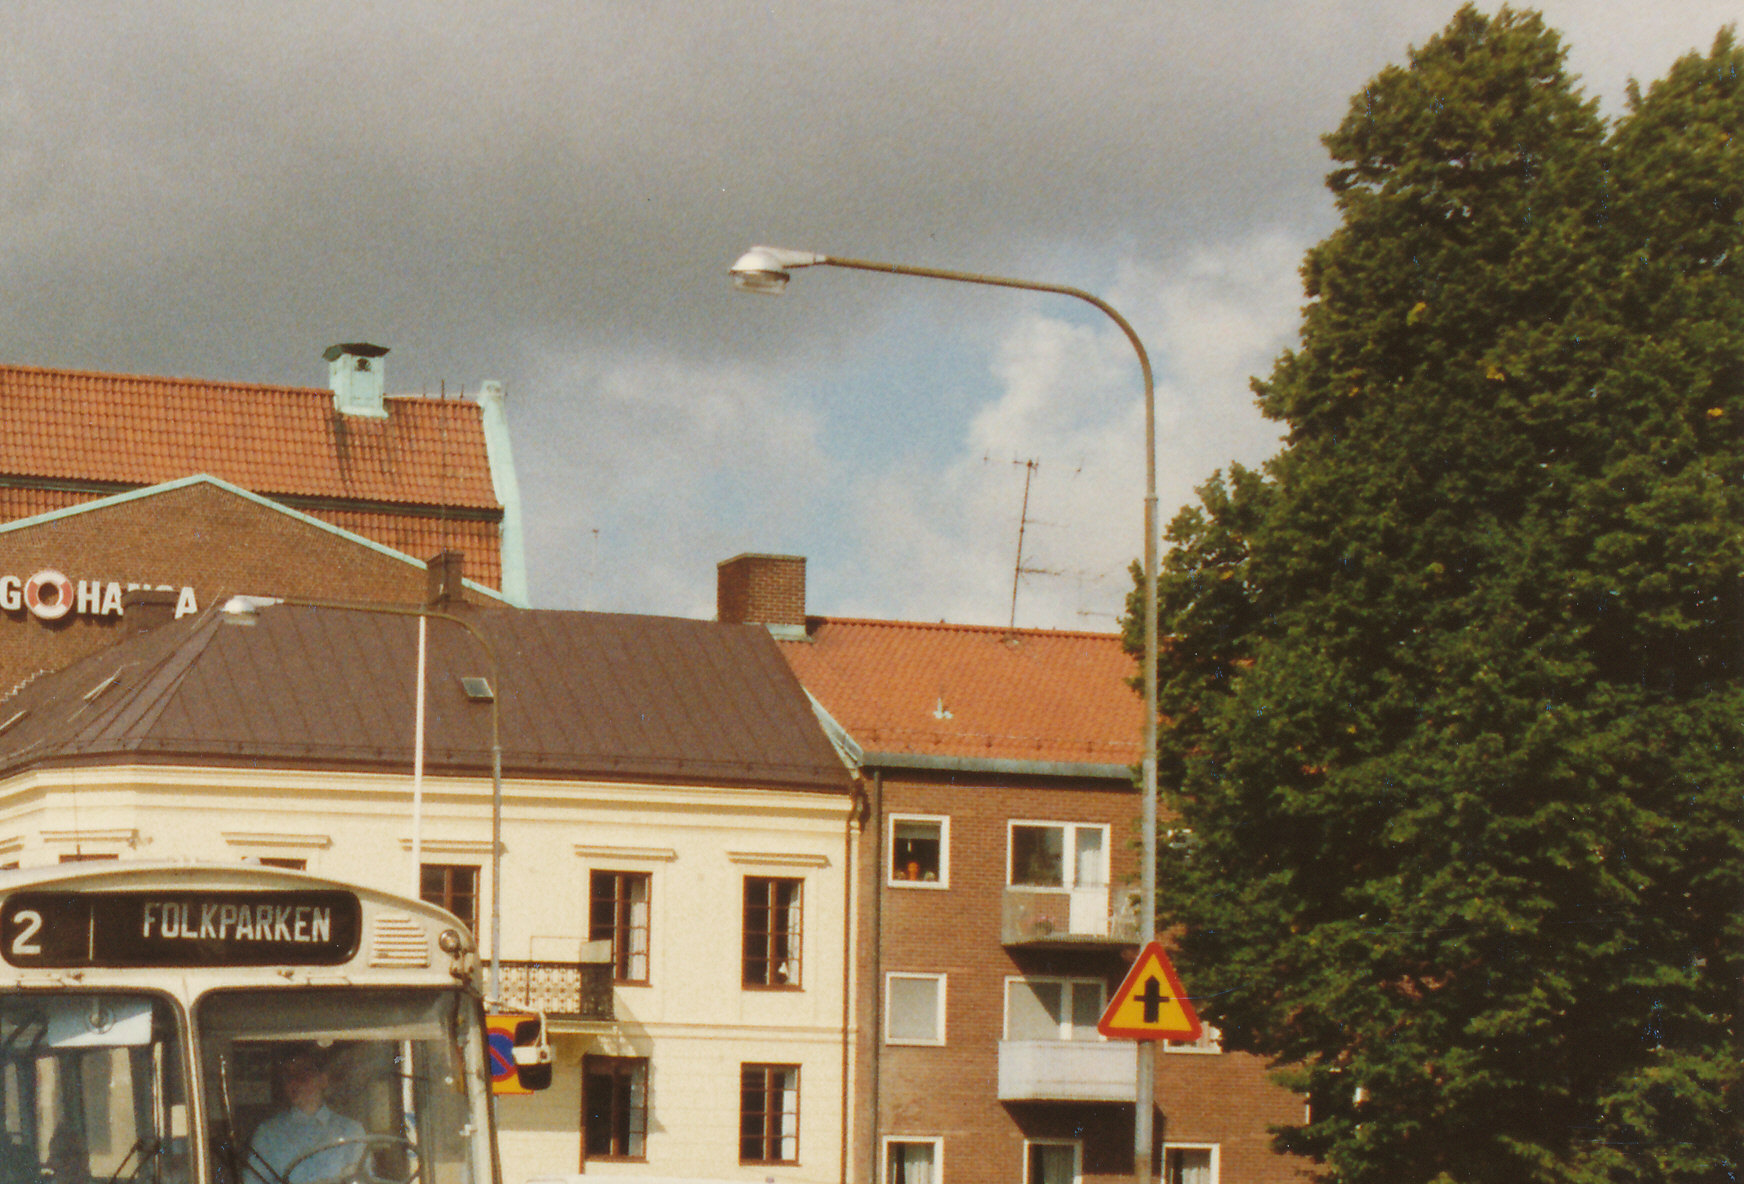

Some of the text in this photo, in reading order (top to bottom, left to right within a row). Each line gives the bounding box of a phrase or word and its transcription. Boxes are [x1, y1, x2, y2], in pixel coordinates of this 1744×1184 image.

[77, 579, 199, 620] HAA
[11, 901, 331, 956] 2 FOLKPARKEN
